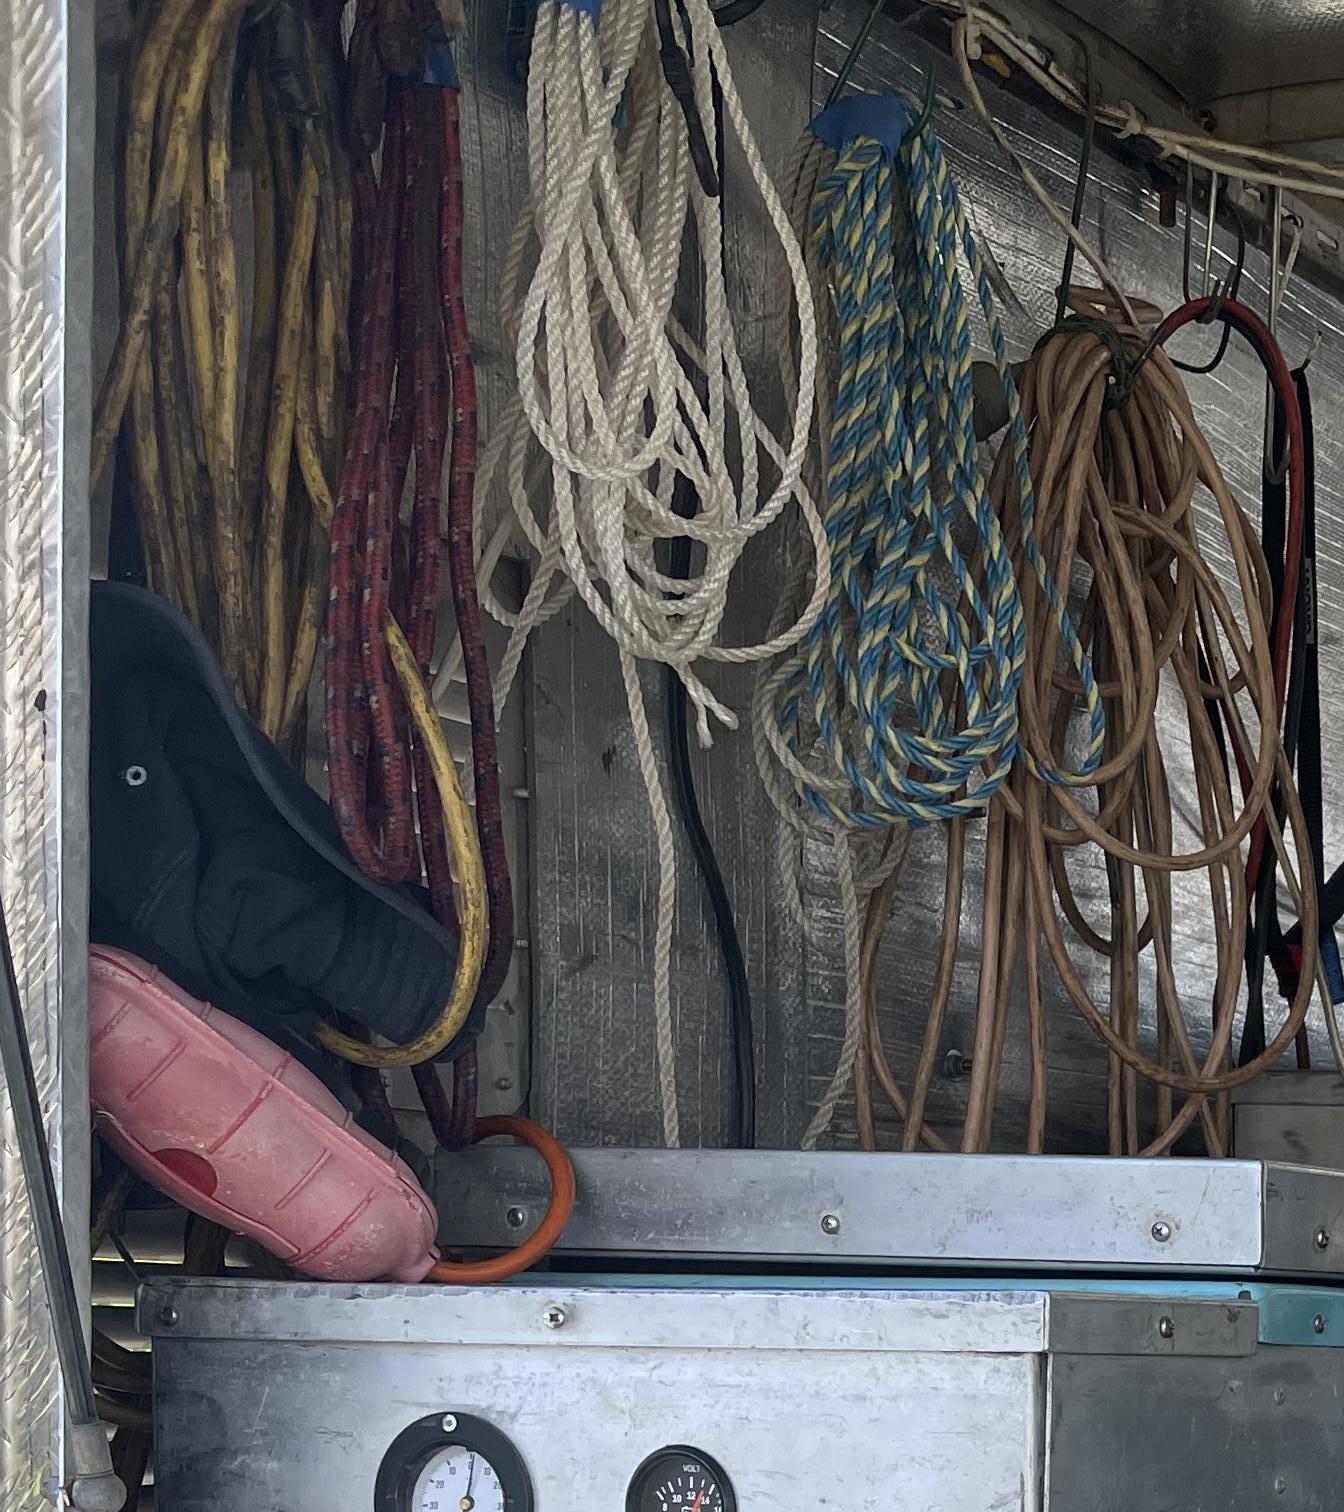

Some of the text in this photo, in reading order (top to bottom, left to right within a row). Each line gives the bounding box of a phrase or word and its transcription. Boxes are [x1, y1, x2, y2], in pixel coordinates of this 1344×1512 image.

[449, 1466, 456, 1475] 10
[682, 1464, 700, 1473] VOLT
[436, 1480, 444, 1488] 20
[672, 1494, 682, 1503] 10
[686, 1491, 696, 1500] 12
[700, 1496, 710, 1505] 14
[430, 1501, 438, 1510] 30
[662, 1502, 668, 1512] 8
